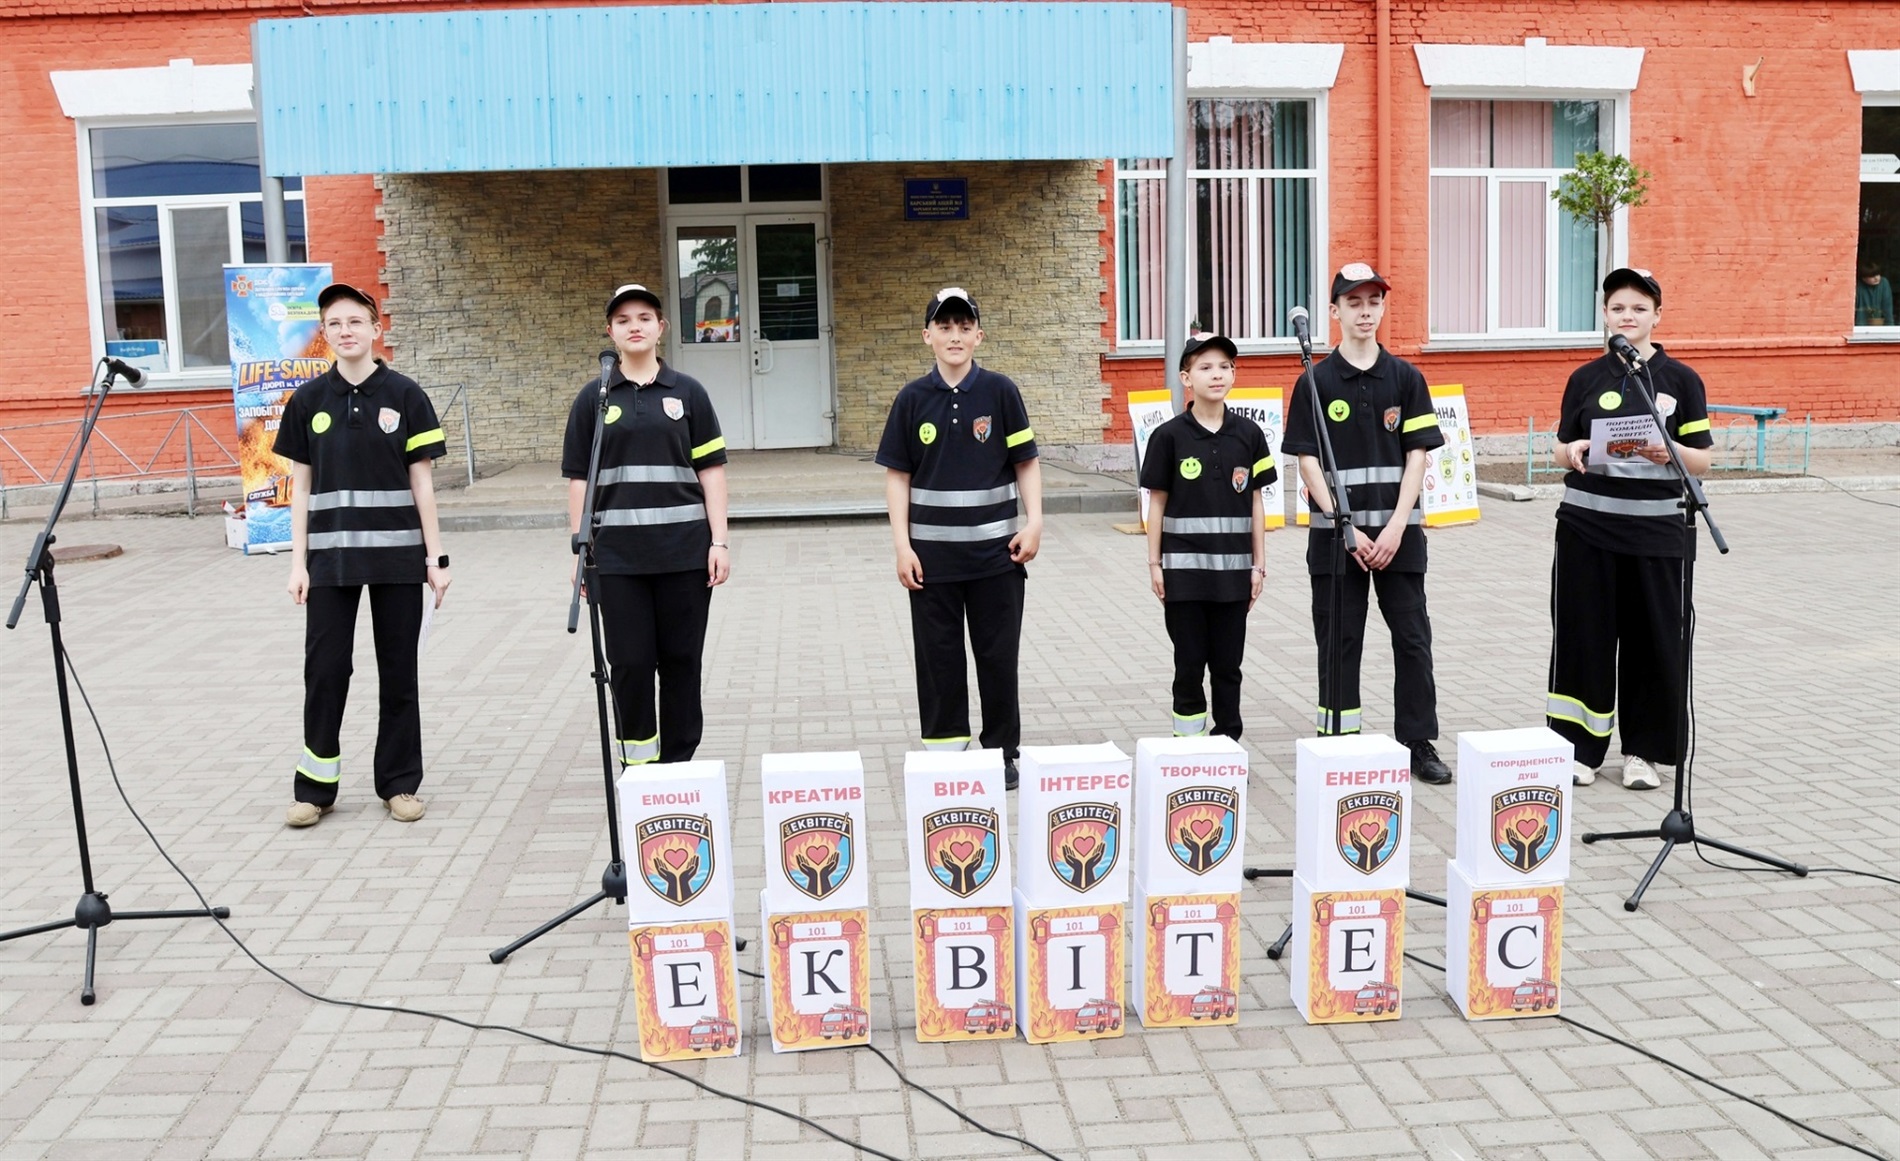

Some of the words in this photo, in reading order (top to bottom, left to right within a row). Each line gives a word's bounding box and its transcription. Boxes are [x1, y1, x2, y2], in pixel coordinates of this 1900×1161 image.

[261, 382, 285, 391] ДЮРП
[1142, 411, 1165, 428] КНИГА
[249, 490, 275, 500] СЛУЖБА
[1490, 757, 1565, 768] СПОРІДНЕНІСТЬ
[1160, 765, 1247, 777] ТВОРЧІСТЬ
[1325, 768, 1410, 786] ЕНЕРГІЯ
[1518, 772, 1539, 781] ДУШ
[1040, 774, 1130, 792] ІНТЕРЕС
[934, 781, 985, 797] ВІРА
[642, 790, 700, 805] ЕМОЦІЇ
[768, 787, 861, 804] КРЕАТИВ
[1348, 905, 1366, 914] 101
[1507, 903, 1524, 912] 101
[1184, 909, 1202, 918] 101
[953, 921, 972, 931] 101
[1066, 921, 1083, 931] 101
[808, 927, 827, 936] 101
[670, 939, 689, 948] 101
